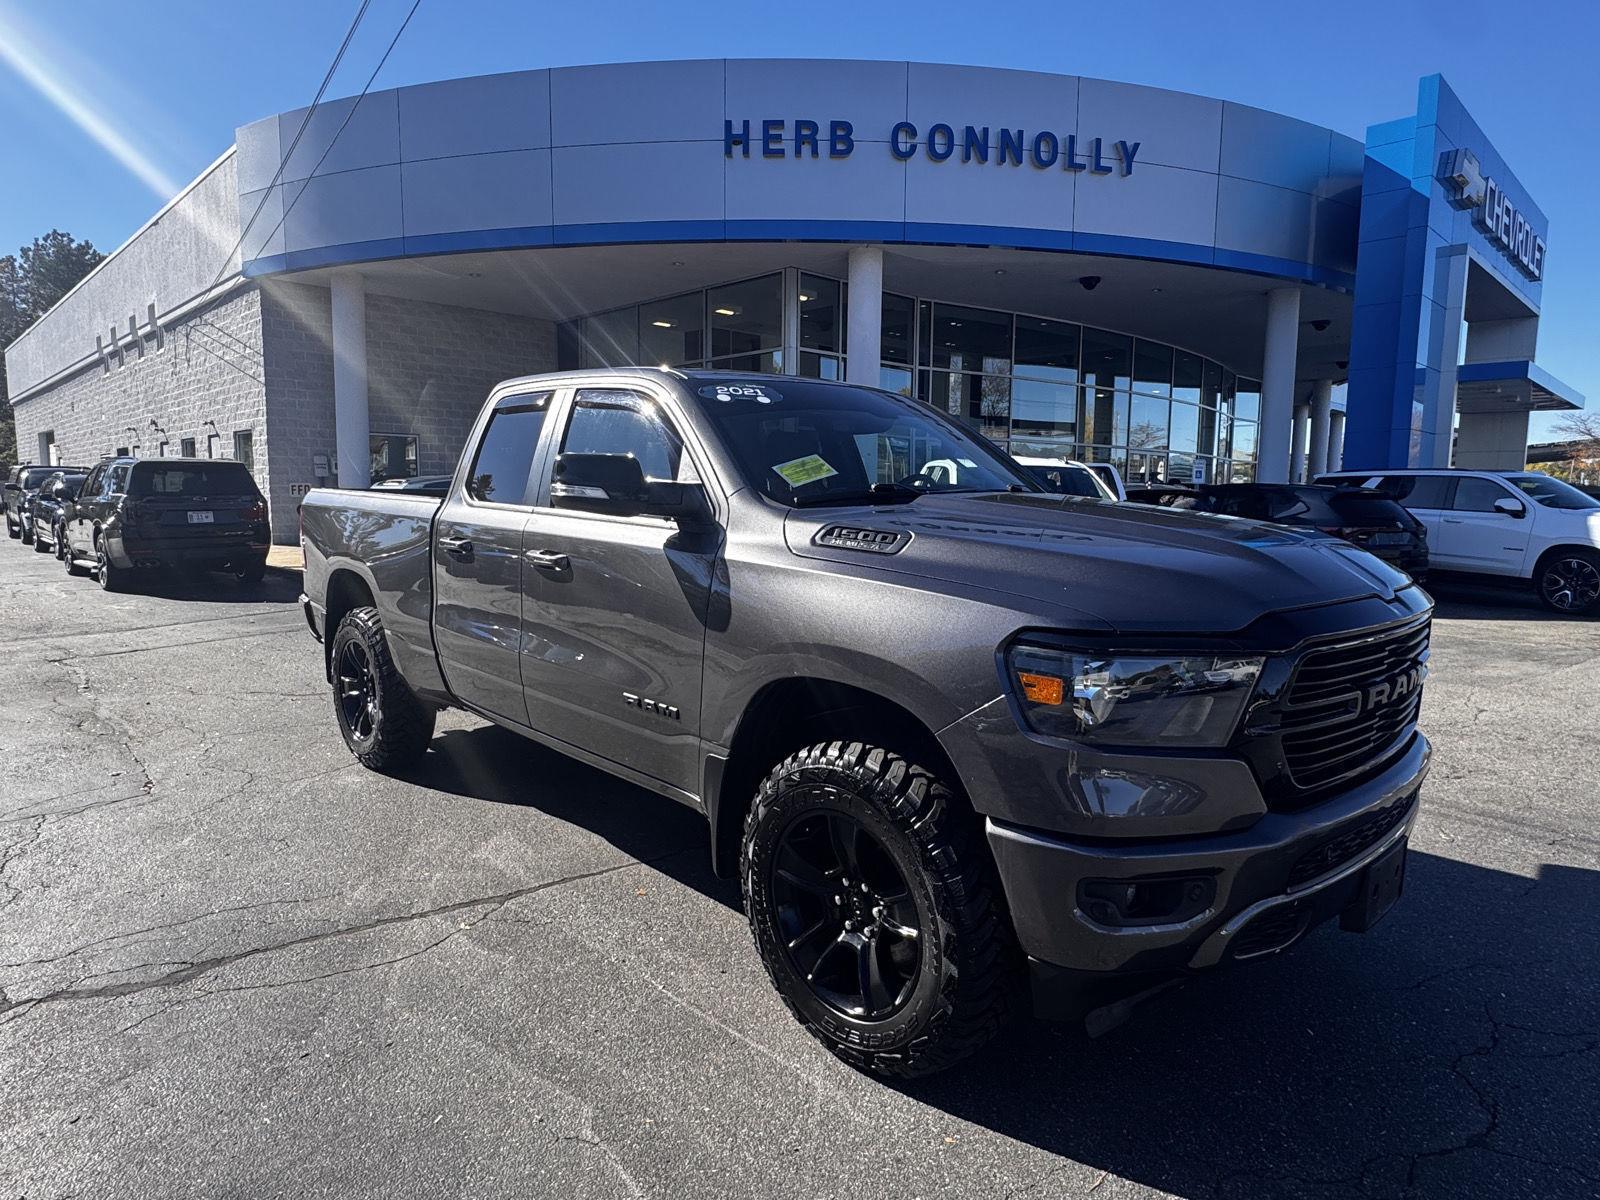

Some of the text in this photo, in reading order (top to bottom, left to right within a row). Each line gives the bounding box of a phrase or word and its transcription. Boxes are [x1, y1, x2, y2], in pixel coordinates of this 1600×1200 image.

[724, 119, 1141, 178] HERB CONNOLLY
[1484, 176, 1546, 280] CHEVROLET
[715, 386, 765, 397] 2021
[832, 527, 895, 544] 1500
[1367, 664, 1424, 710] RAM
